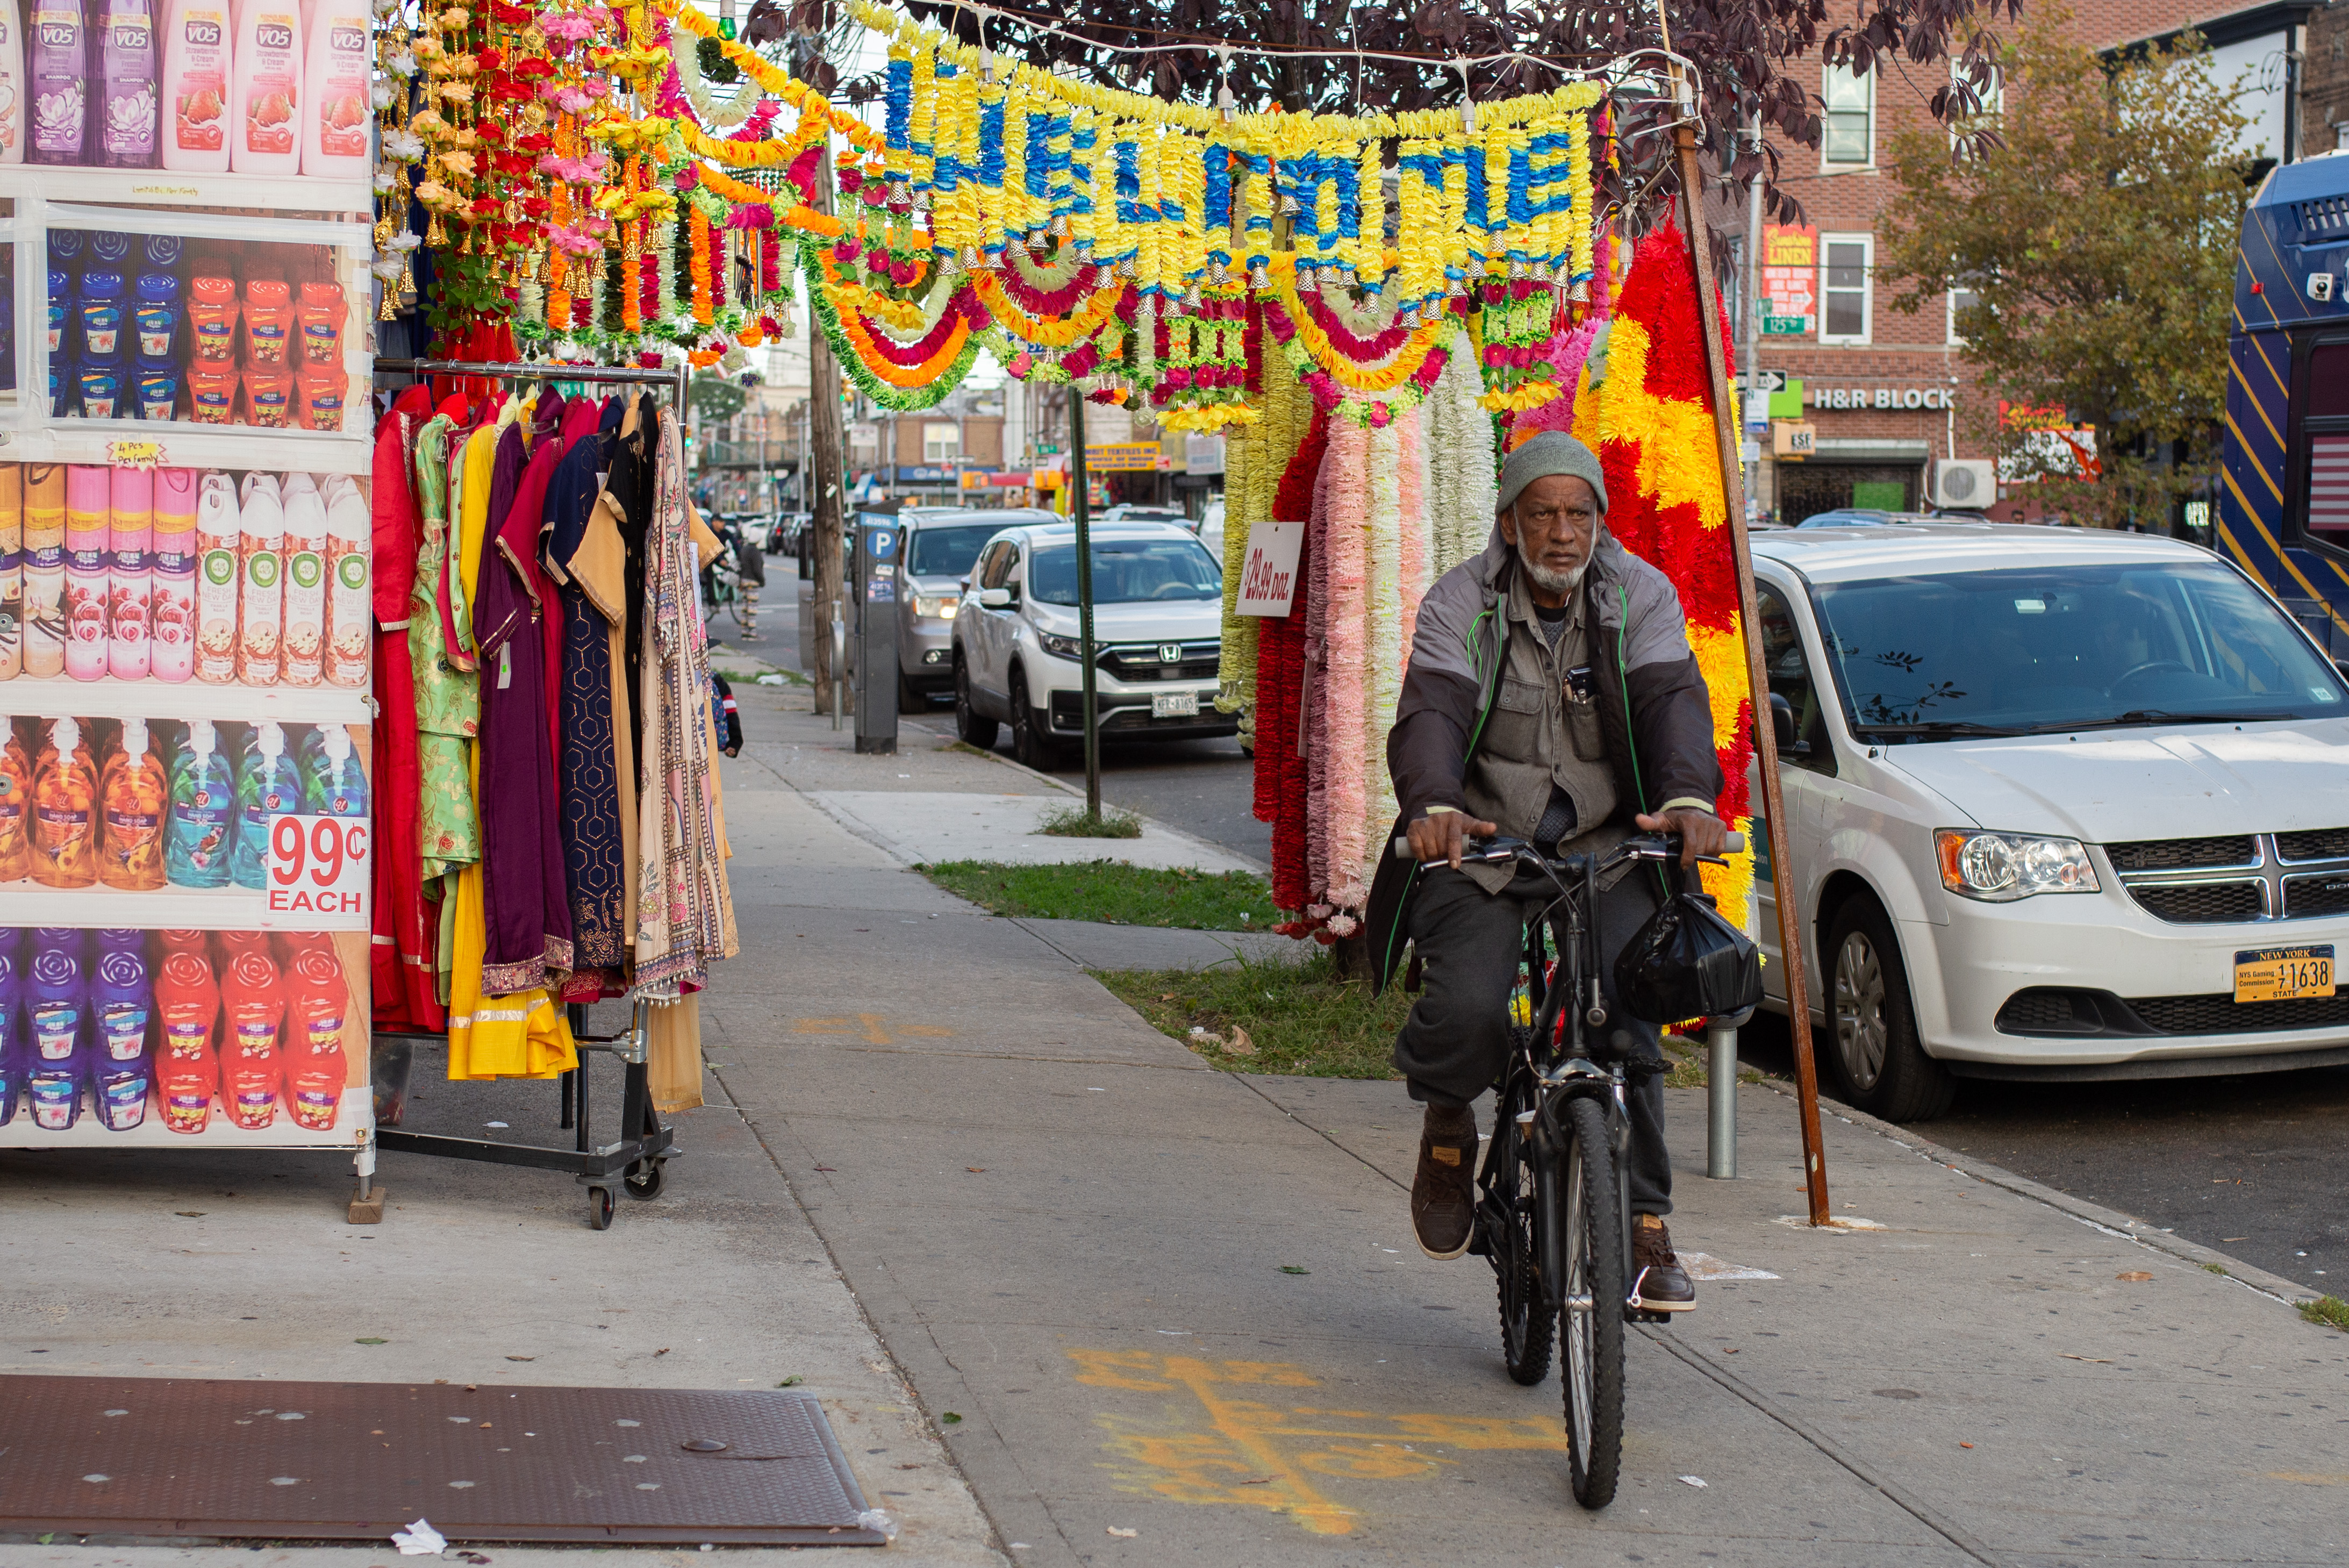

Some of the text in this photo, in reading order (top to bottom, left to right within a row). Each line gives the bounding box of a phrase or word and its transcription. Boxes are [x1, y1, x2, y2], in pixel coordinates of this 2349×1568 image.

[42, 28, 74, 44] VO5
[116, 31, 147, 47] VO5
[188, 26, 219, 42] VO5
[258, 30, 289, 45] VO5
[332, 32, 363, 48] VO5
[1768, 246, 1812, 266] LINEN
[1770, 318, 1787, 332] 125
[1814, 388, 1956, 409] H&R BLOCK
[876, 532, 892, 555] P
[1245, 547, 1273, 600] $29.99
[202, 591, 220, 600] NEW
[207, 586, 232, 595] FRESH
[247, 593, 264, 603] NEW
[252, 589, 276, 597] FRESH
[289, 593, 306, 603] NEW
[294, 589, 318, 597] FRESH
[270, 890, 361, 913] EACH
[2259, 951, 2283, 961] NEW
[2285, 949, 2310, 958] YORK
[2273, 990, 2297, 998] STATE
